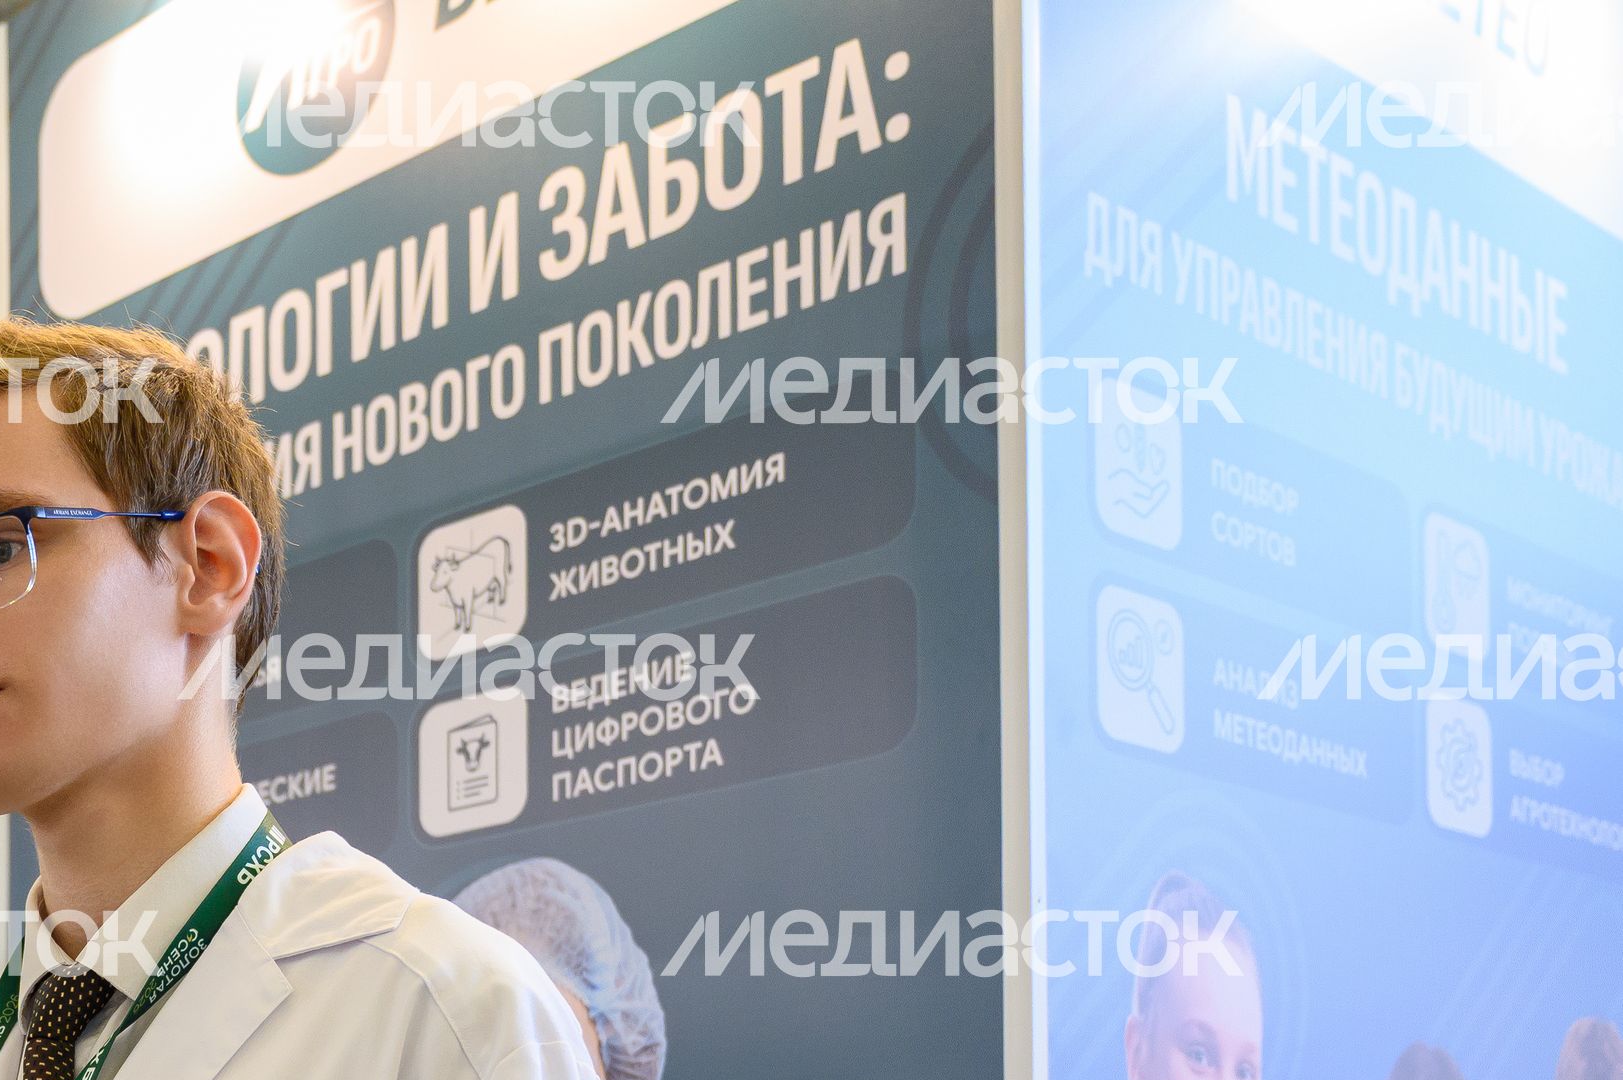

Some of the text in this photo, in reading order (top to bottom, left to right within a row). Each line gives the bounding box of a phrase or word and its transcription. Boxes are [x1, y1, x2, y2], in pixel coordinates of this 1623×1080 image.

[467, 191, 520, 314] И
[538, 38, 912, 281] ЗАБОТА:
[1226, 92, 1569, 376] МЕТЕОДАННЫЕ
[1084, 190, 1163, 297] ДЛЯ
[1171, 229, 1389, 401] УПРАВЛЕНИЯ
[331, 344, 525, 483] НОВОГО
[537, 192, 908, 405] ПОКОЛЕНИЯ
[548, 451, 787, 553] 3D-АНАТОМИЯ
[1210, 457, 1300, 518] ПОДБОР
[548, 518, 737, 602] ЖИВОТНЫХ
[1210, 510, 1298, 568] СОРТОВ
[551, 650, 693, 714] ВЕДЕНИЕ
[551, 682, 757, 762] ЦИФРОВОГО
[551, 738, 724, 803] ПАСПОРТА
[1213, 707, 1369, 782] МЕТЕОДАННЫХ
[149, 938, 208, 1003] ЗОЛОТАЯ
